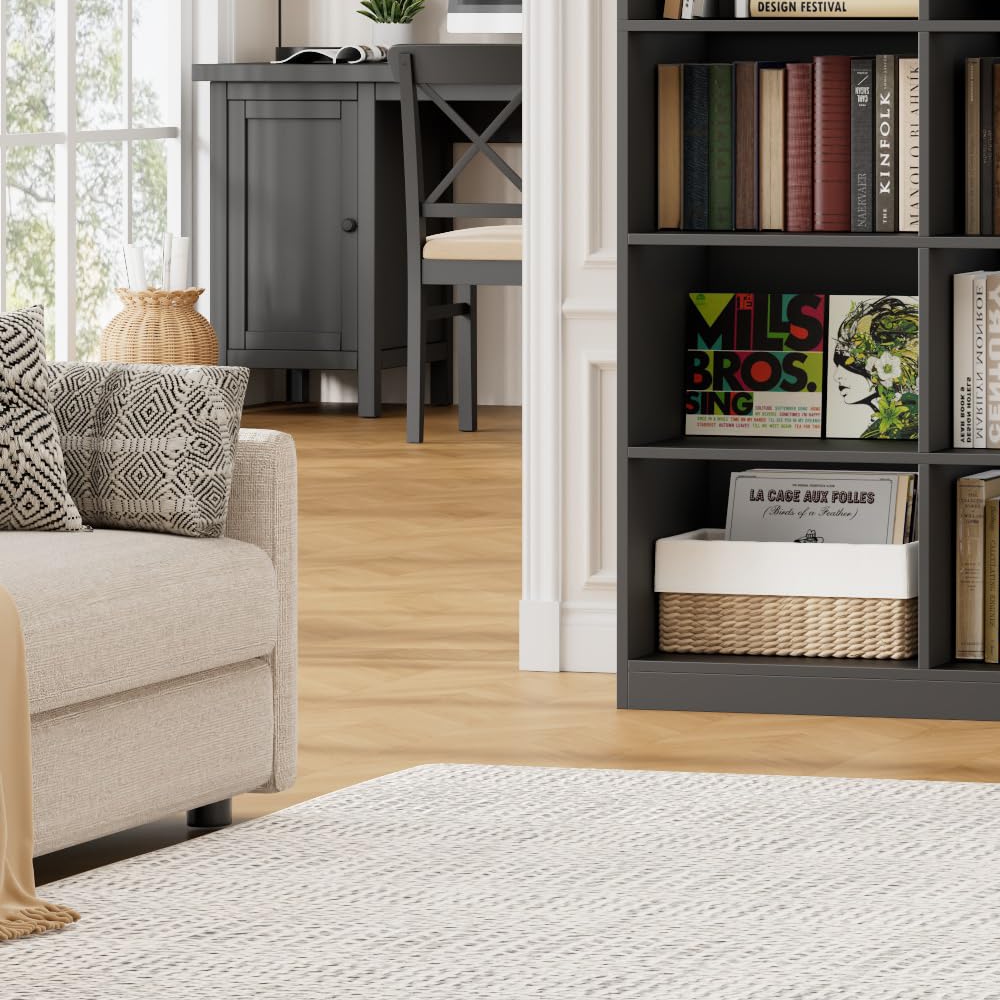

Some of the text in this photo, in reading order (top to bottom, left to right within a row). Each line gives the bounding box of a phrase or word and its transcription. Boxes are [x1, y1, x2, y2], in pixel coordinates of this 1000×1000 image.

[757, 1, 847, 13] DESIGN FESTIVAL
[879, 92, 891, 195] KINFOLK
[688, 293, 823, 351] MILLS
[687, 351, 818, 393] BROS.
[685, 392, 754, 415] SING
[750, 488, 875, 504] LA CAGE AUX FOLLES
